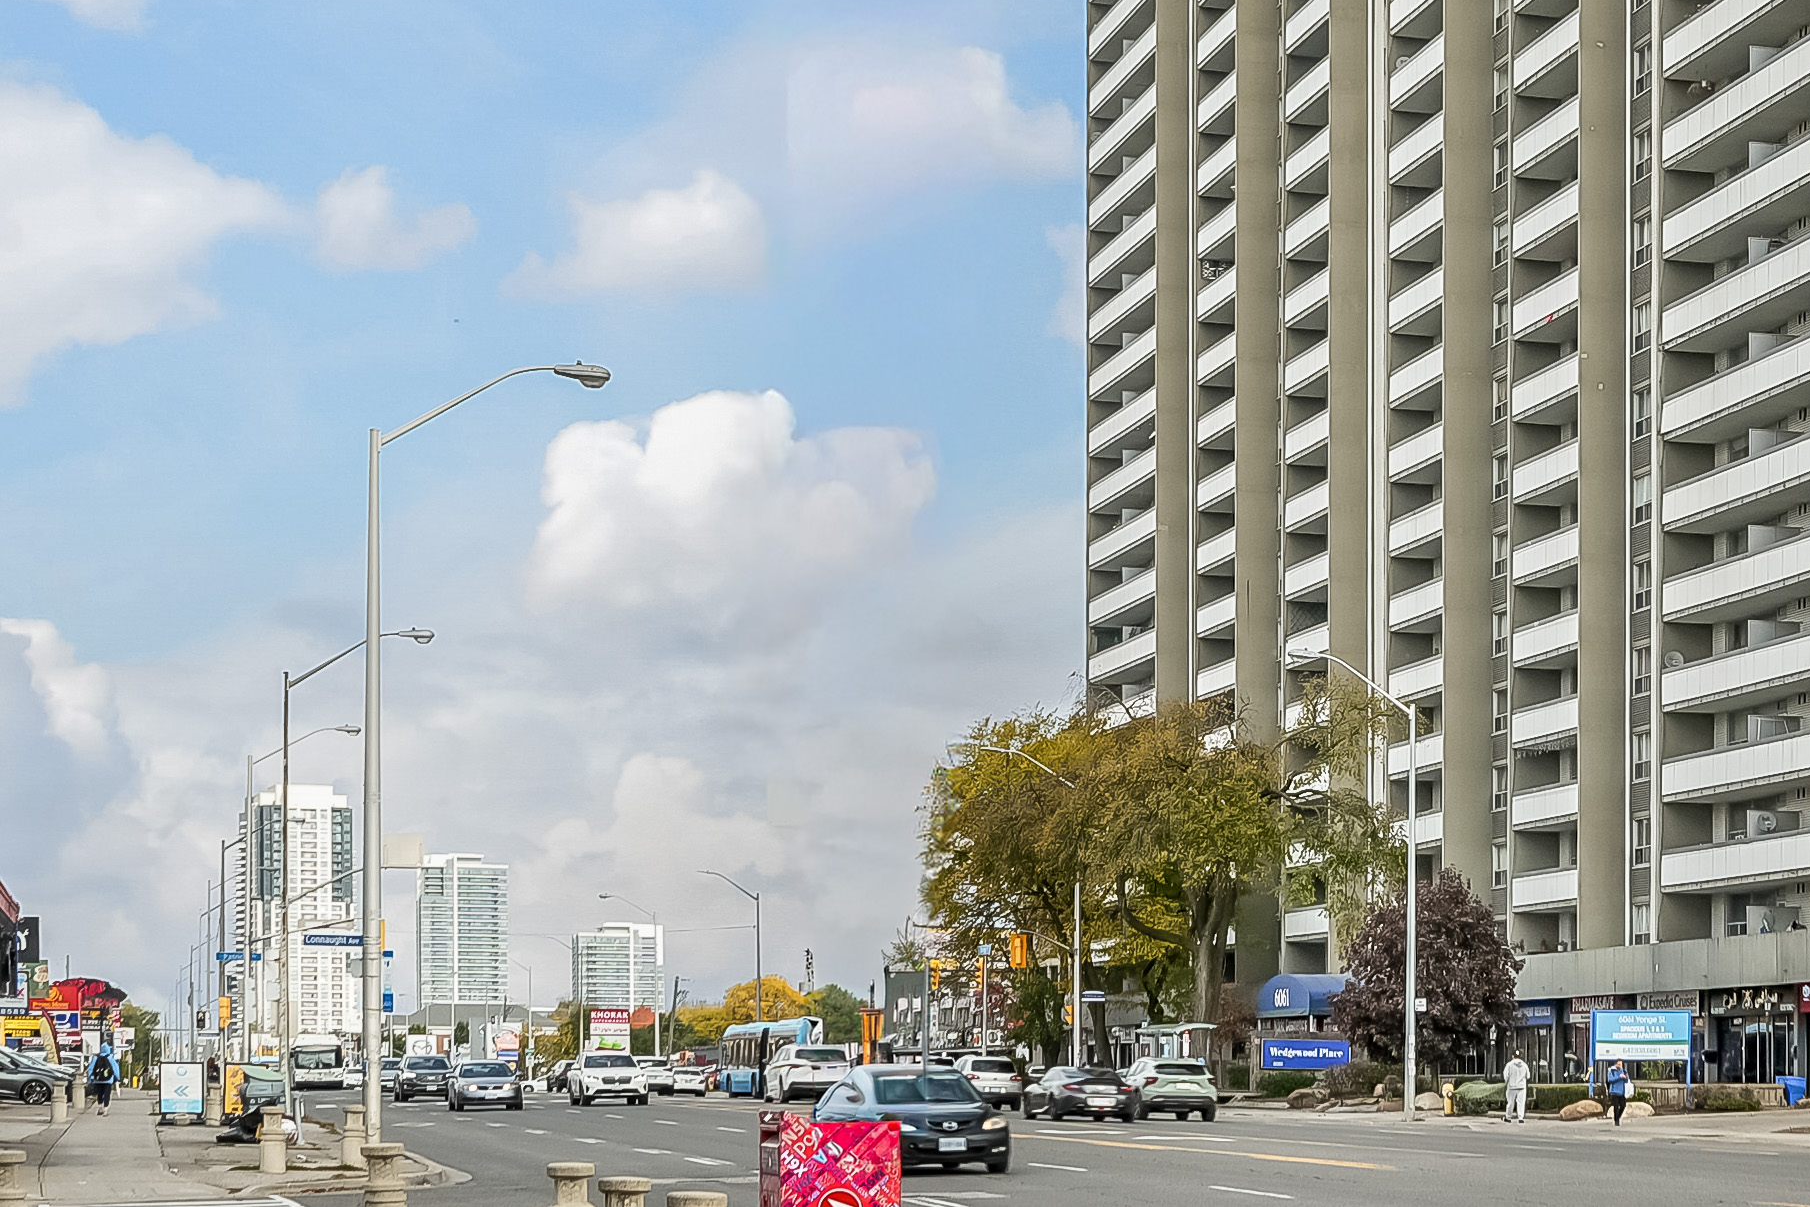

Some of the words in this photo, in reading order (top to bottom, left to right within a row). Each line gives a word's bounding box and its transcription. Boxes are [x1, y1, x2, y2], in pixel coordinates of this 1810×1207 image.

[306, 934, 347, 945] Connaught
[1274, 989, 1290, 1007] 6061
[1572, 997, 1614, 1012] PHARMASAVE
[1650, 995, 1674, 1010] Expedia
[1674, 994, 1698, 1008] Cruises
[591, 1011, 629, 1019] KHORAK
[1636, 1016, 1658, 1024] Yonge
[1269, 1046, 1318, 1059] Wedgewood
[1319, 1047, 1344, 1058] Place
